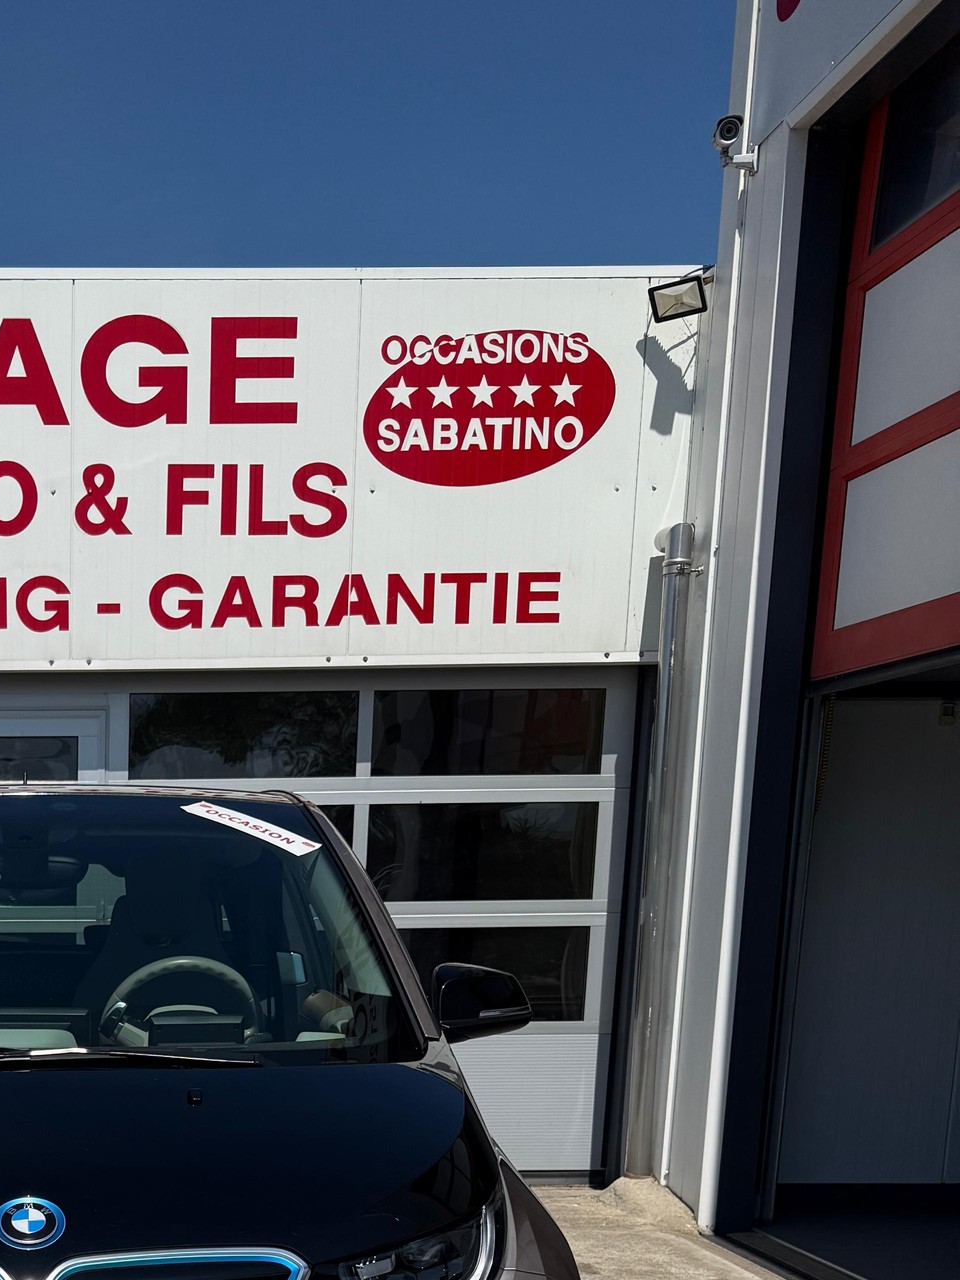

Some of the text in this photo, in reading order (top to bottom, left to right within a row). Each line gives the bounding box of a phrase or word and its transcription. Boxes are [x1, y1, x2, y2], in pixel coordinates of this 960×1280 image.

[381, 332, 589, 366] OCCASIONS
[377, 415, 583, 452] SABATINO
[75, 463, 130, 536] &
[166, 462, 348, 538] FILS
[149, 571, 561, 629] GARANTIE
[206, 808, 296, 845] OCCASION
[7, 1203, 52, 1215] BMW
